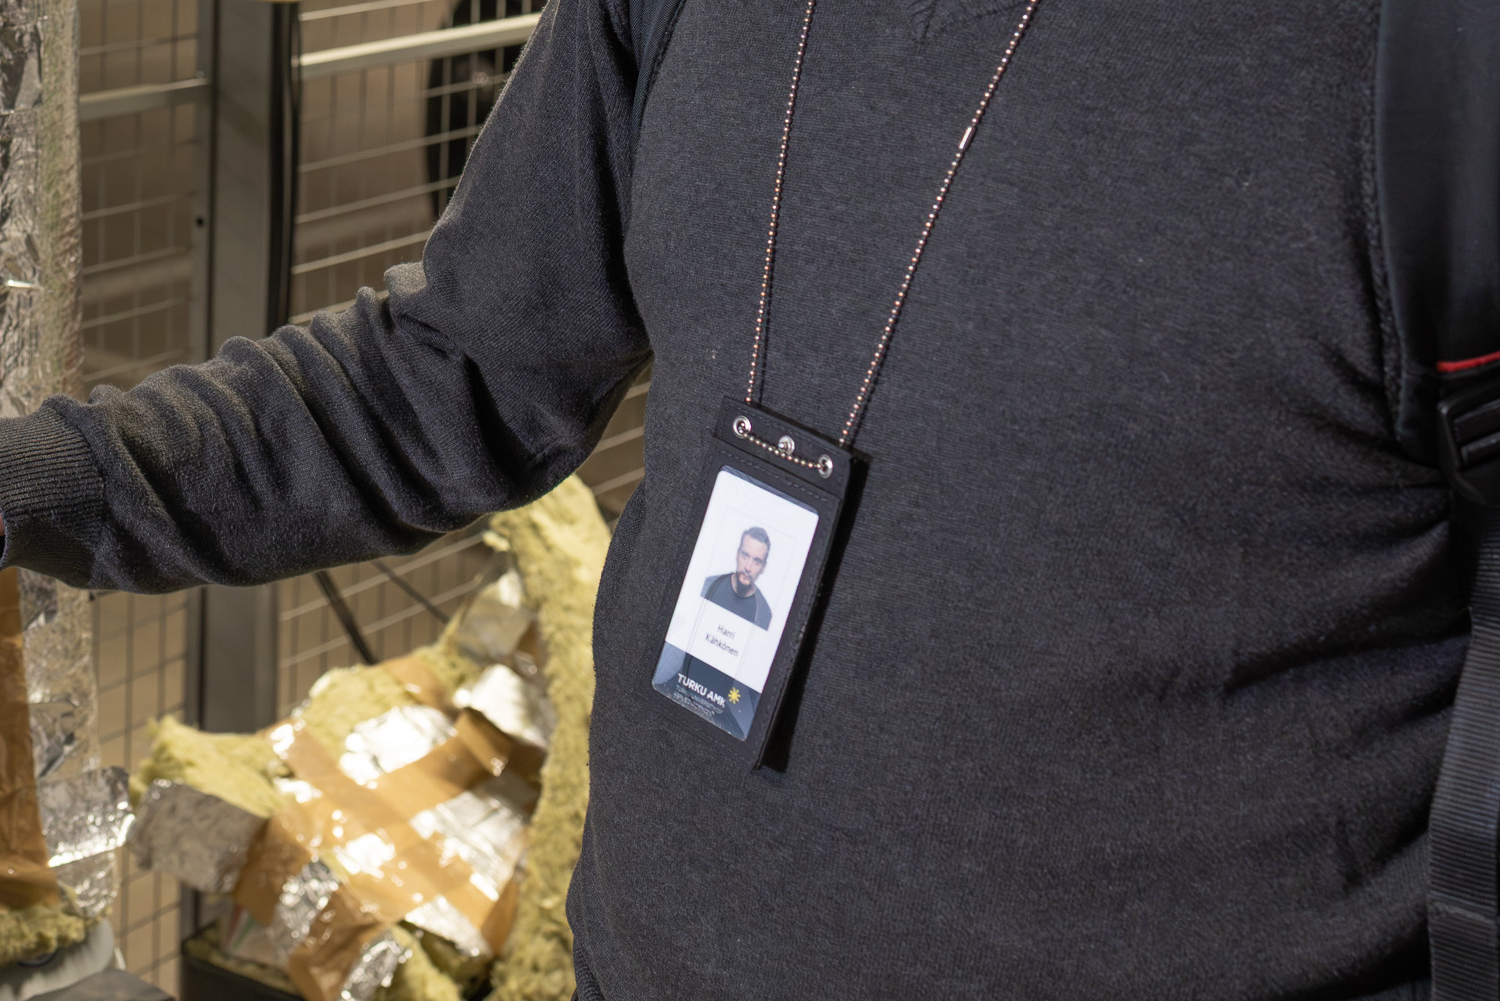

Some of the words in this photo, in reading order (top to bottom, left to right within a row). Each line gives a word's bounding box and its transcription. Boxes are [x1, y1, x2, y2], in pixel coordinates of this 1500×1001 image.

[717, 624, 735, 640] Harri
[678, 672, 707, 696] TURKU
[706, 690, 726, 708] AMK
